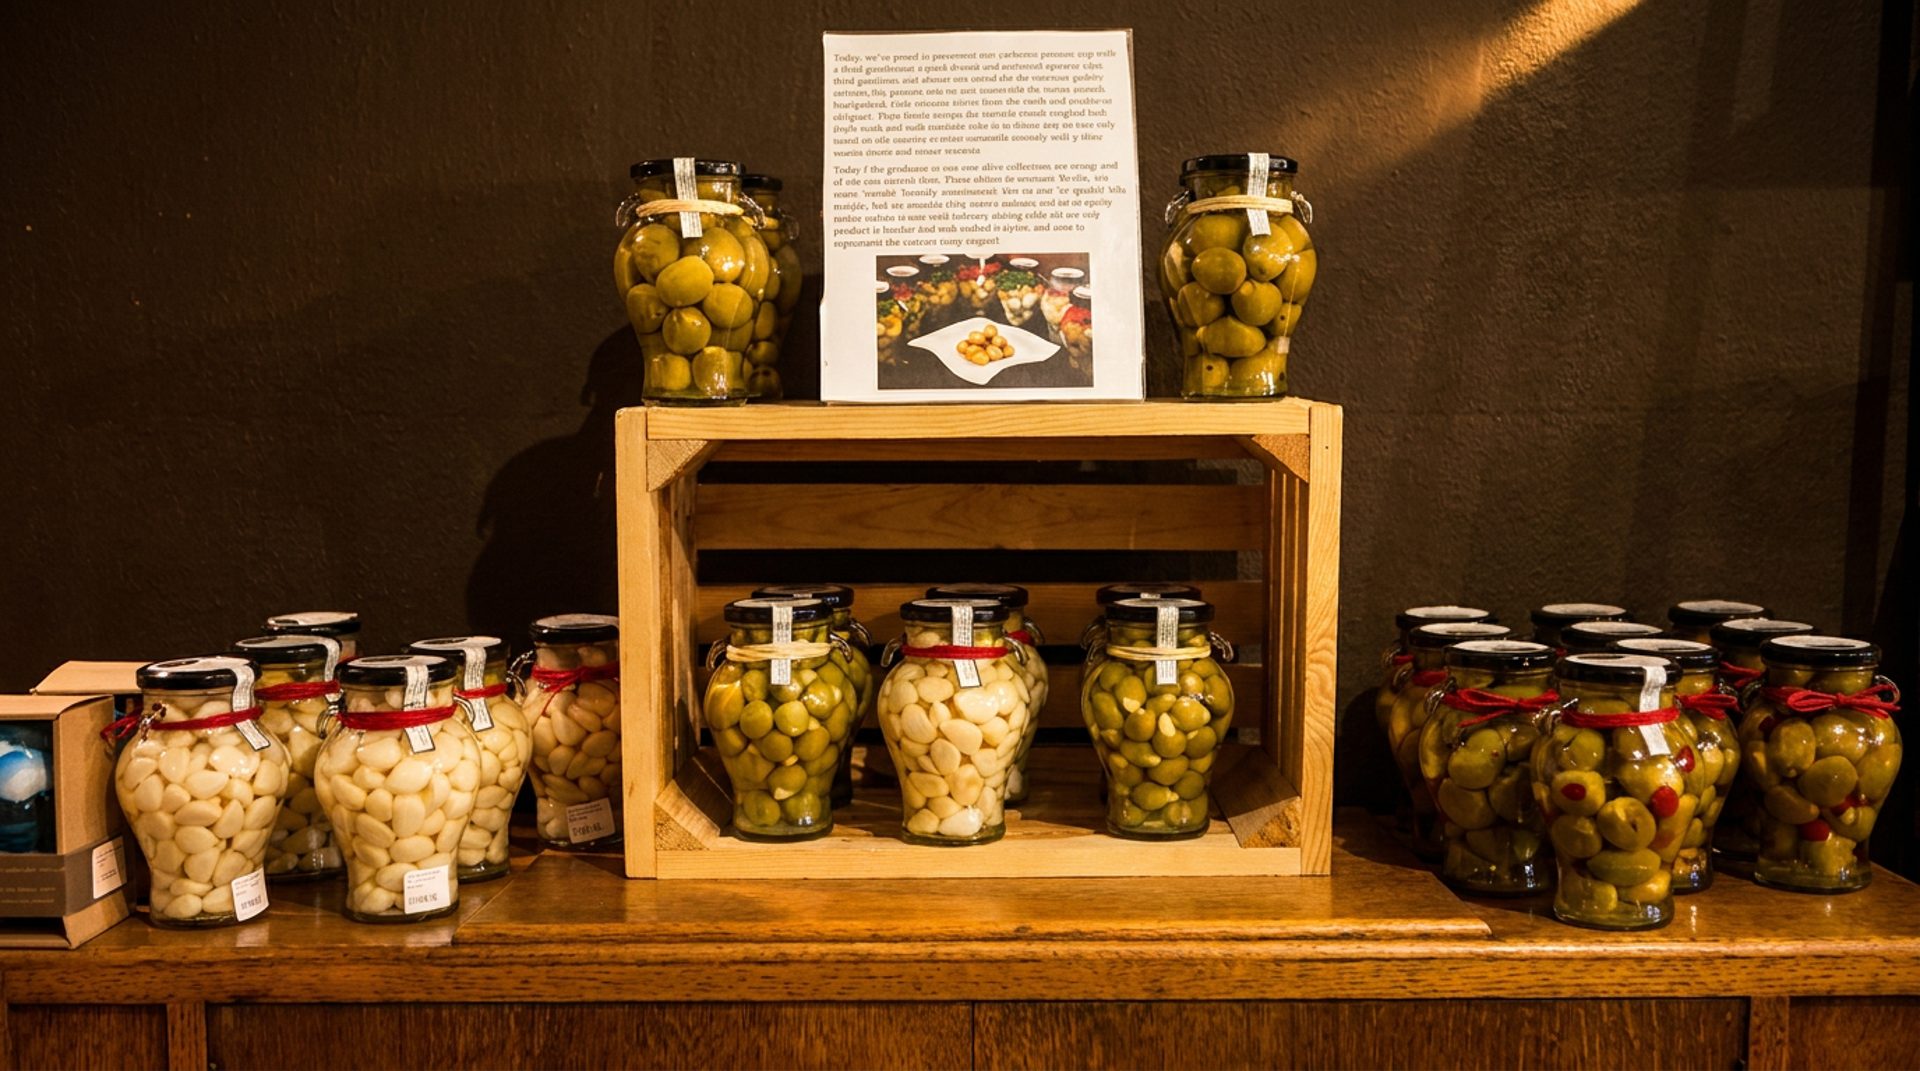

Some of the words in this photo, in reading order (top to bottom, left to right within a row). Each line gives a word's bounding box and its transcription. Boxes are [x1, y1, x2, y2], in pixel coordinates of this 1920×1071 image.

[833, 76, 855, 85] third
[1072, 134, 1079, 143] y
[834, 165, 861, 176] Today
[870, 165, 885, 174] the
[982, 163, 1004, 172] alive
[833, 177, 843, 186] of
[1033, 223, 1050, 232] and
[1076, 223, 1085, 231] to
[885, 238, 900, 247] the
